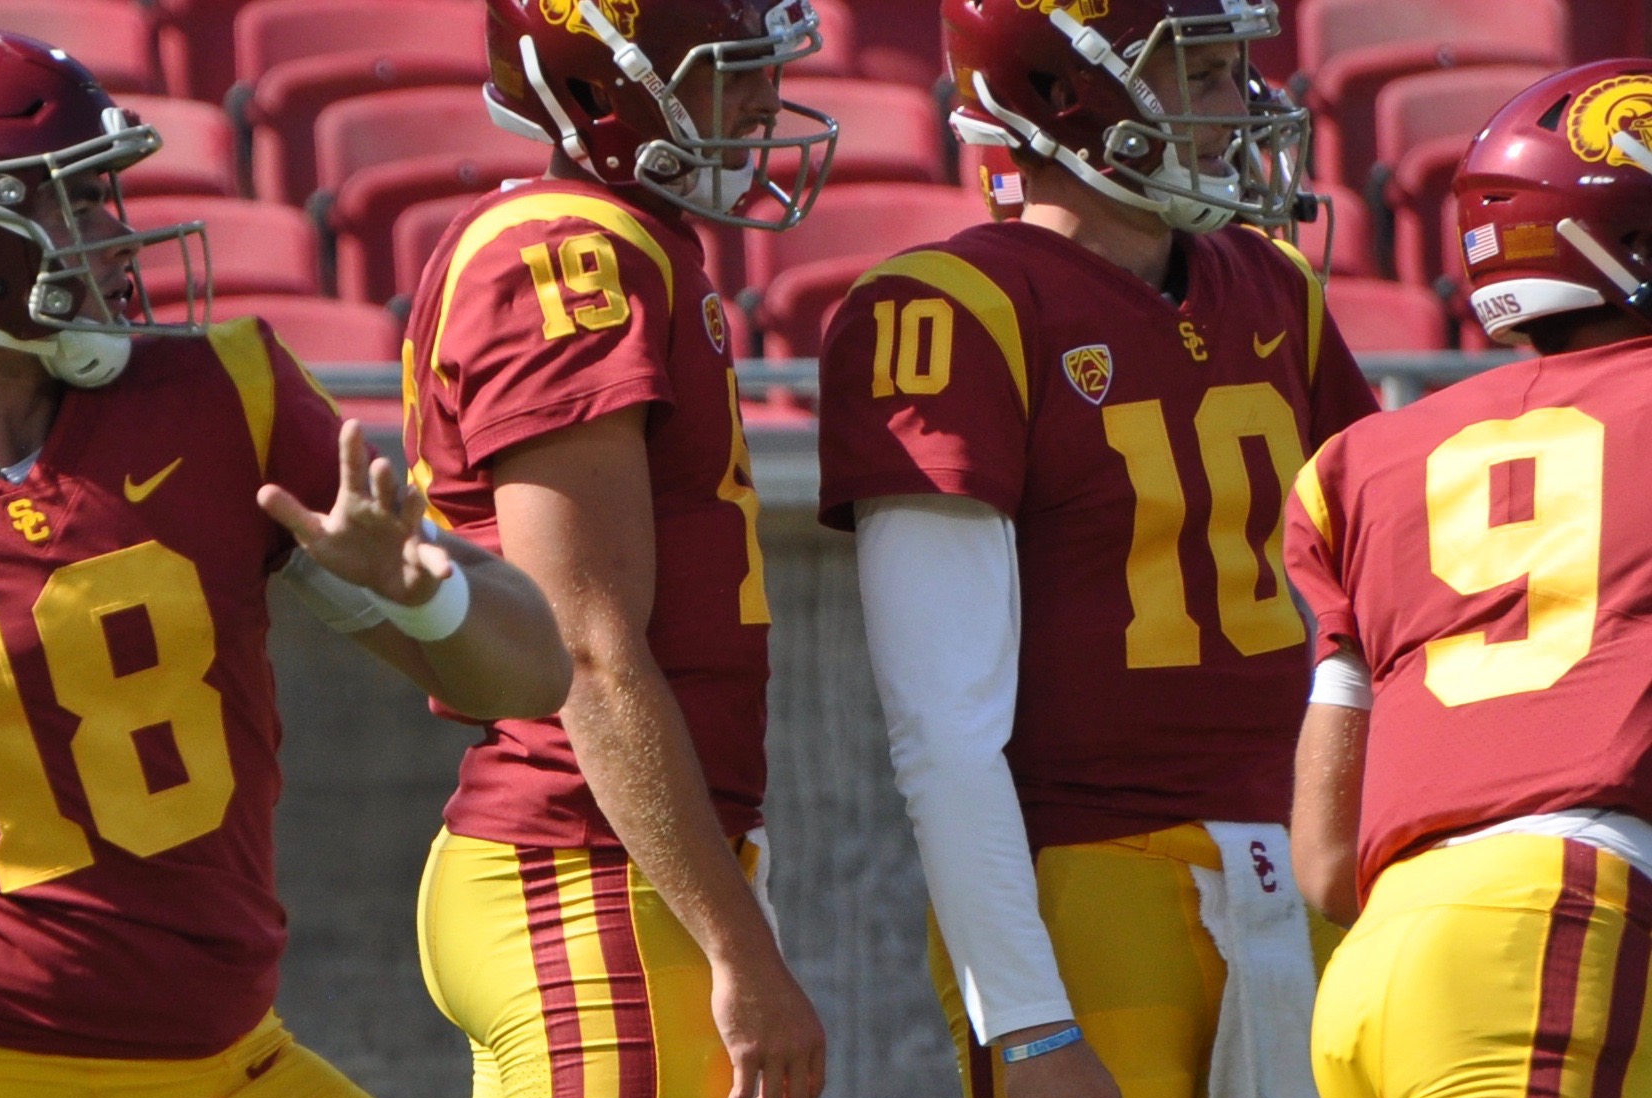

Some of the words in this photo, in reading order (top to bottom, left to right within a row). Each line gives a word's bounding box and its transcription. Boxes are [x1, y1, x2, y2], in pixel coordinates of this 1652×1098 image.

[519, 231, 630, 341] 19
[871, 298, 954, 399] 10
[1066, 348, 1110, 384] PAC
[1080, 369, 1105, 393] 12
[7, 498, 50, 542] SC
[1101, 381, 1308, 669] 10
[1423, 406, 1605, 708] 9
